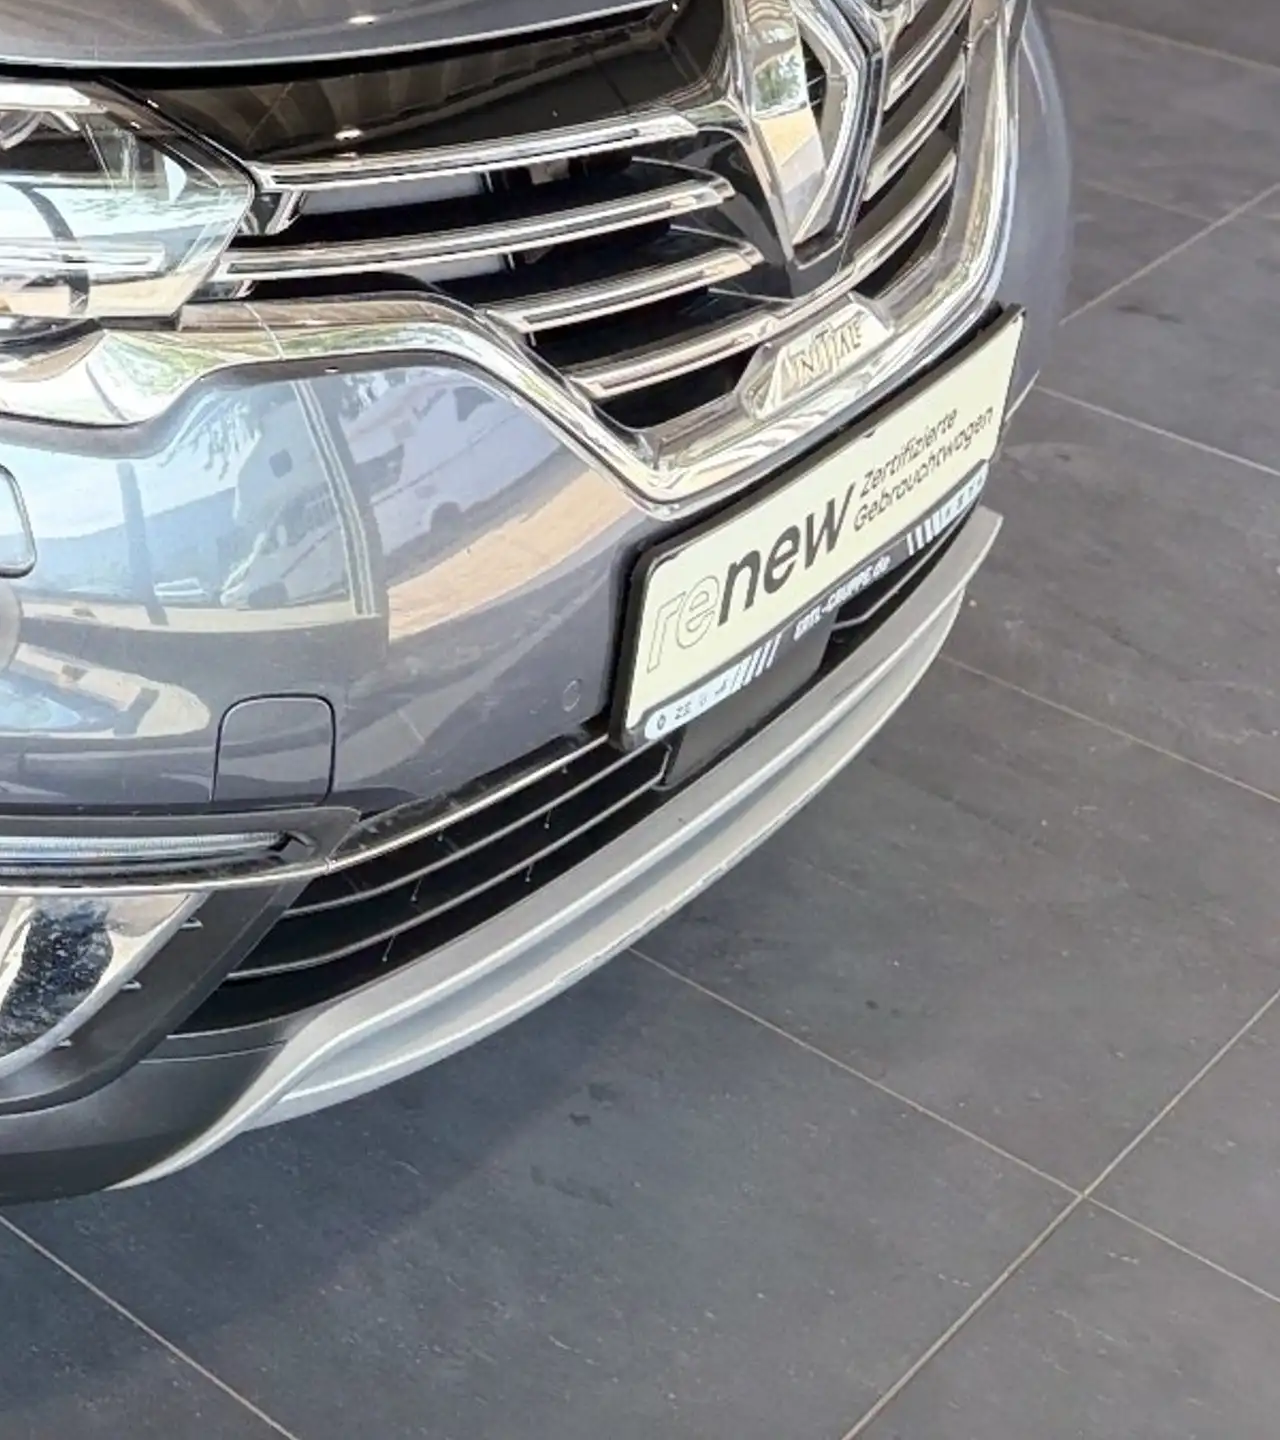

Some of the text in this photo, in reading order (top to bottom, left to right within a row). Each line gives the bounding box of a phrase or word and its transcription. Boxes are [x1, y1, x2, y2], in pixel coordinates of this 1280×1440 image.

[853, 406, 994, 532] Gebrauchtwagen
[860, 408, 958, 498] Zertifizierte
[646, 482, 856, 674] renew
